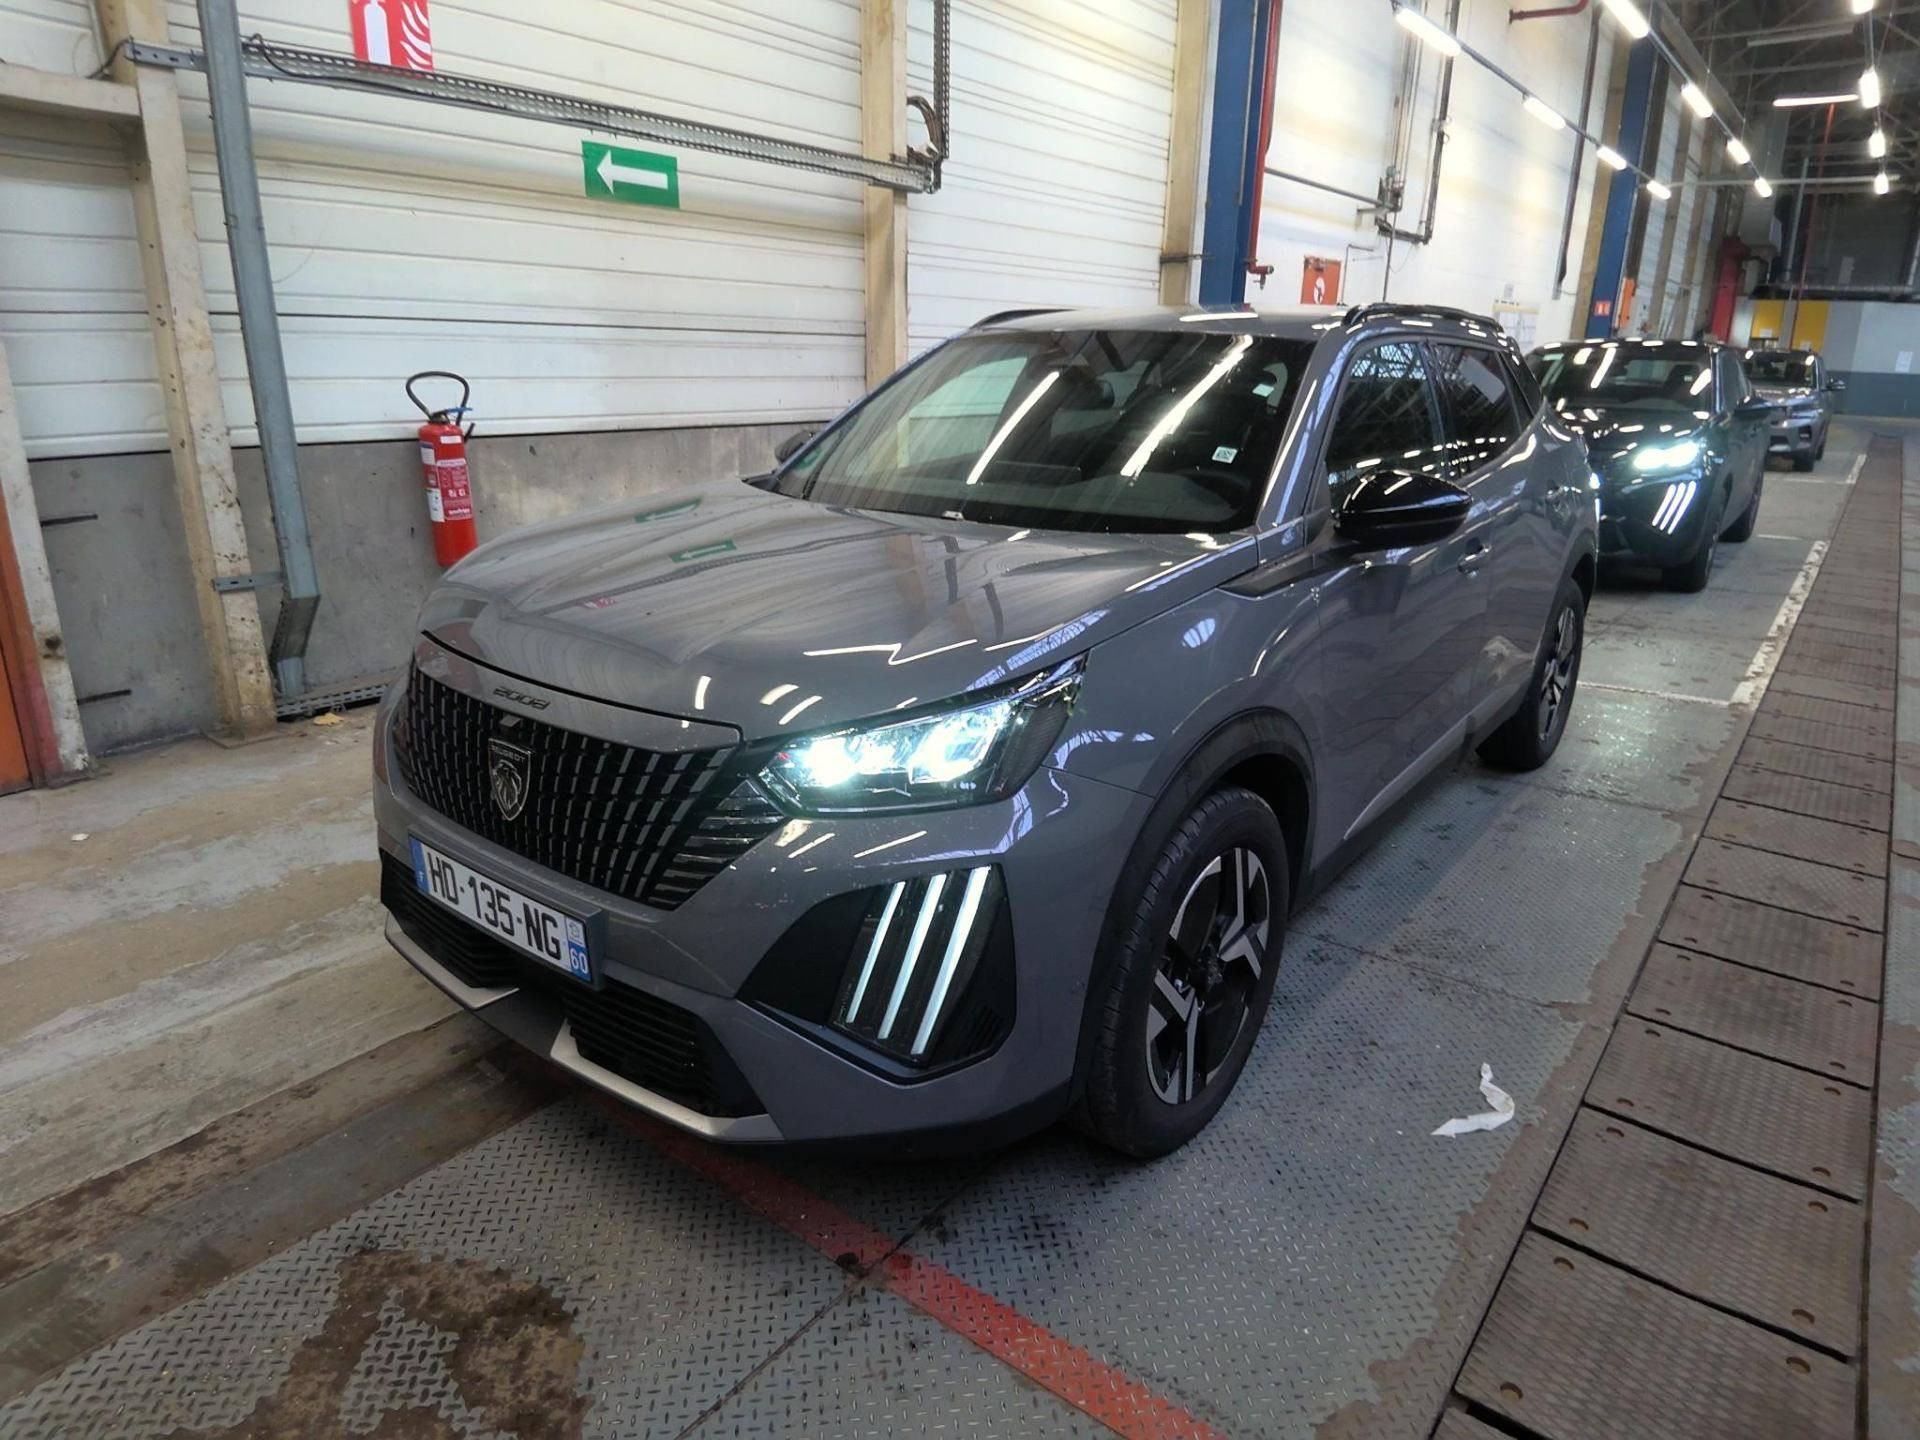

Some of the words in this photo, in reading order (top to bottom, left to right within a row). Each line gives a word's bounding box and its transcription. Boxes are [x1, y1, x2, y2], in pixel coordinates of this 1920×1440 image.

[493, 687, 551, 710] 2008
[427, 851, 561, 960] HD-135-NG
[570, 947, 588, 974] 60
